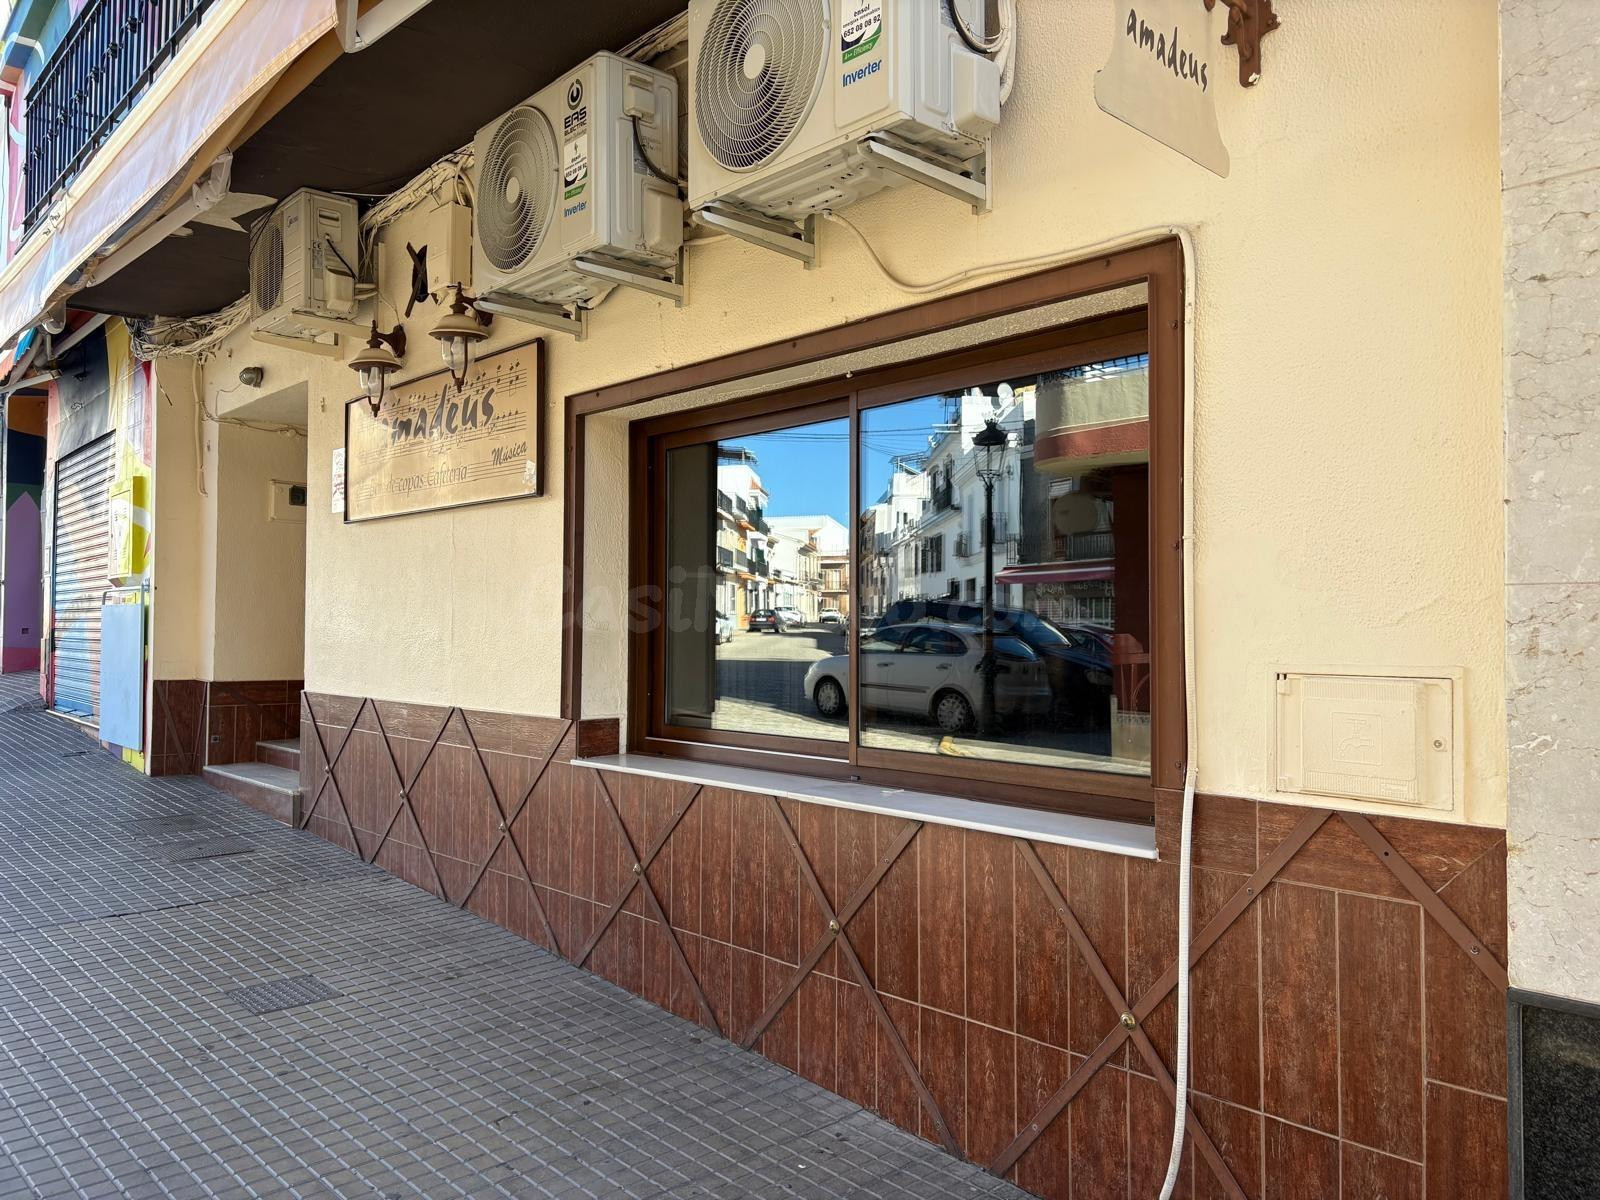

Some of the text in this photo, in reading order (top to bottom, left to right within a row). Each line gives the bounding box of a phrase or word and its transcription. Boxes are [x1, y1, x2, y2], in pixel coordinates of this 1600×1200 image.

[1127, 8, 1207, 93] amadeus
[842, 60, 882, 87] Inverter
[564, 106, 587, 129] EAS
[379, 384, 495, 448] madeus
[491, 441, 527, 468] Música
[399, 472, 424, 498] copas
